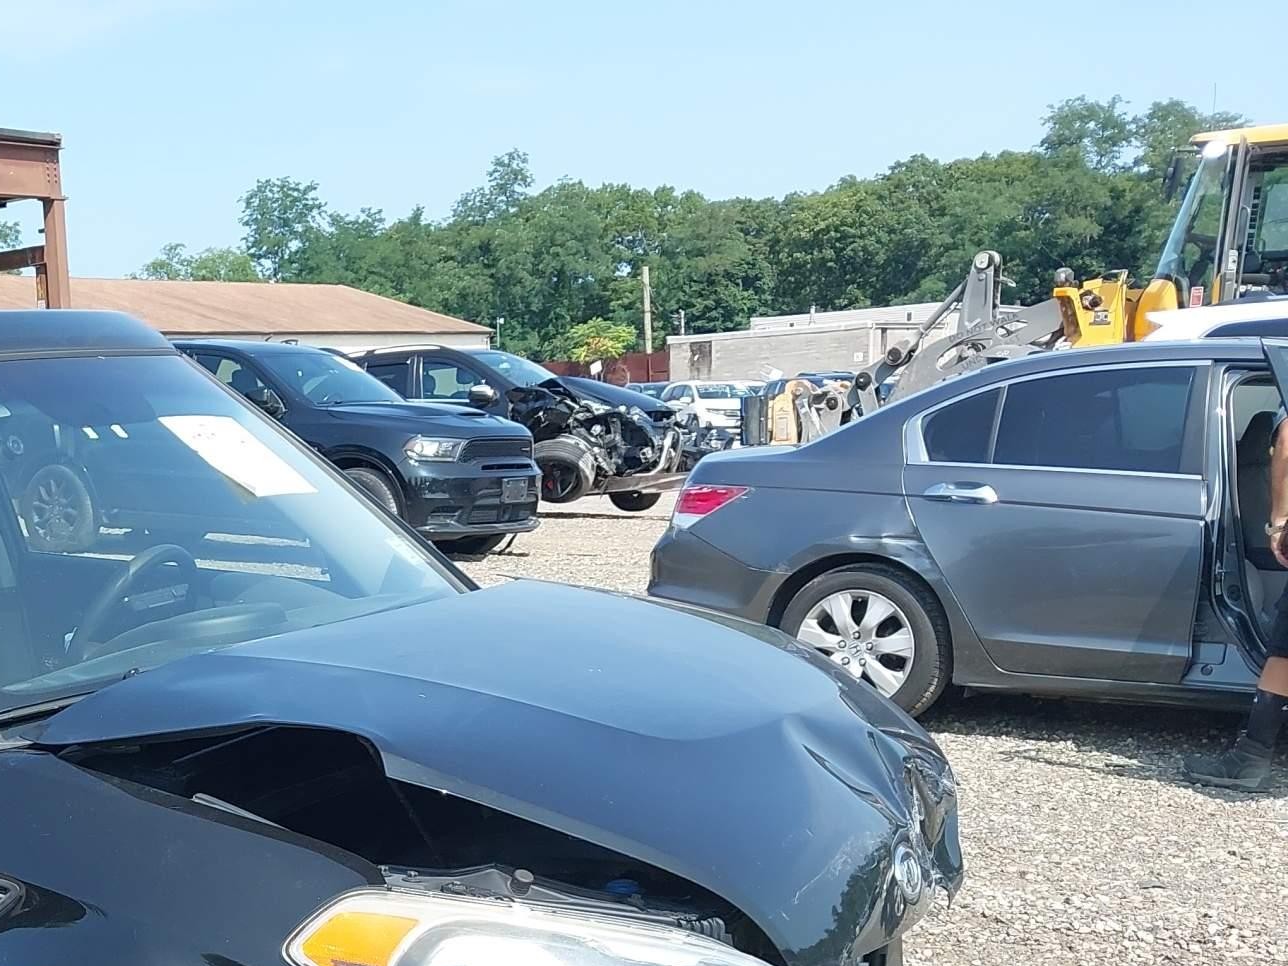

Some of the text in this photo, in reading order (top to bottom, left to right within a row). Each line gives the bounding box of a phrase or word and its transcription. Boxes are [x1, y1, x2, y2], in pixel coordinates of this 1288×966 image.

[948, 313, 1019, 343] DO NOT WALK
